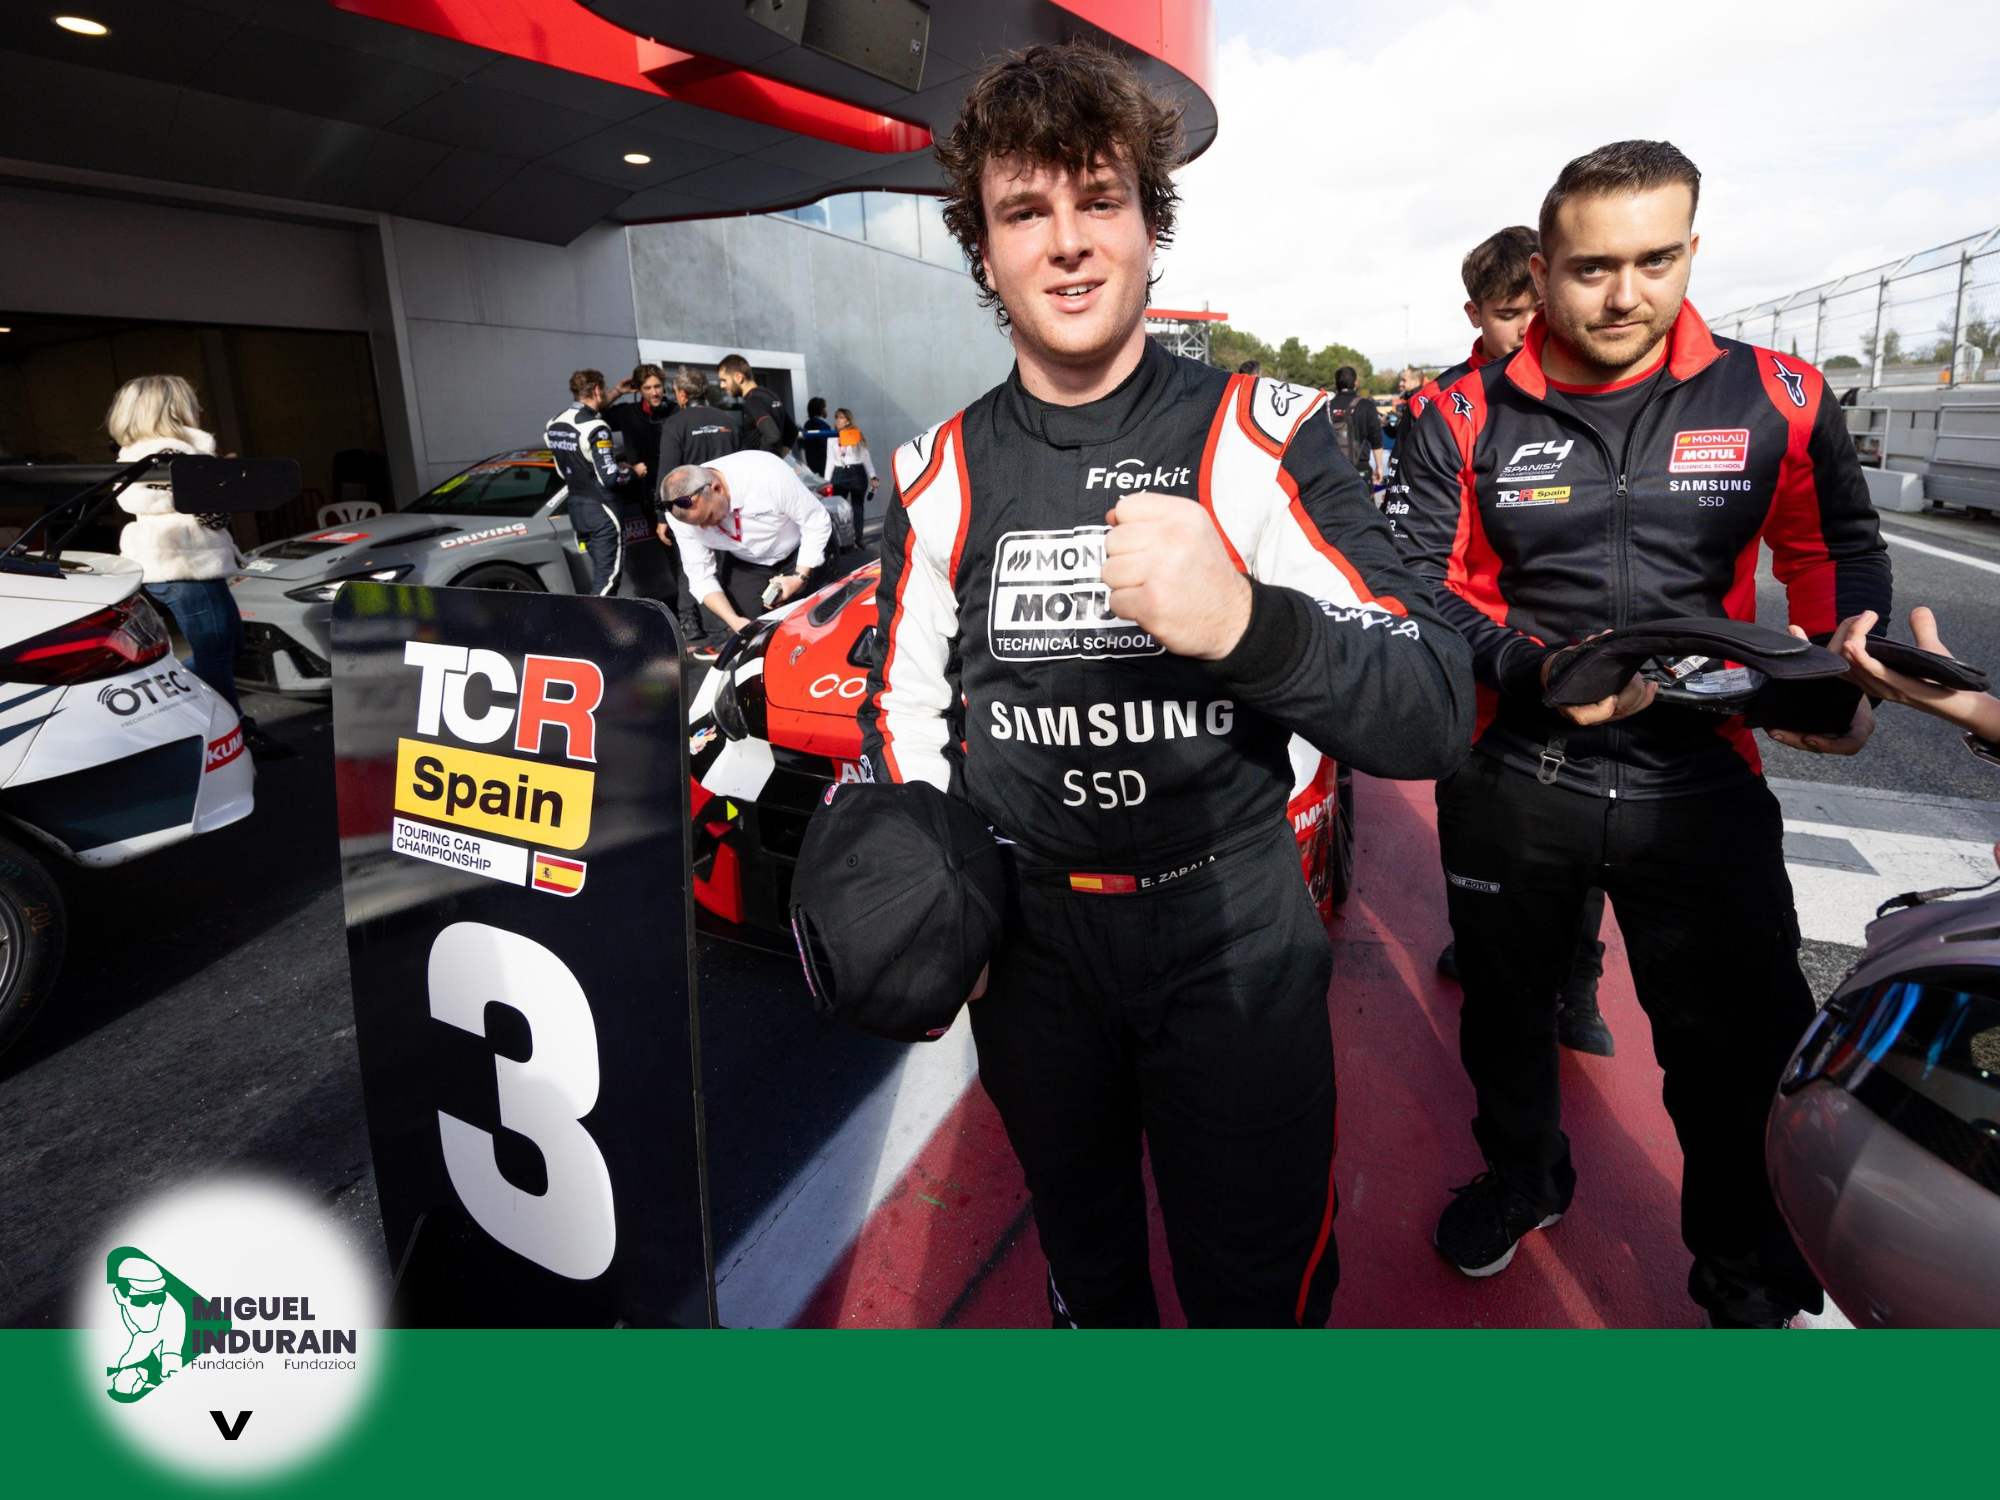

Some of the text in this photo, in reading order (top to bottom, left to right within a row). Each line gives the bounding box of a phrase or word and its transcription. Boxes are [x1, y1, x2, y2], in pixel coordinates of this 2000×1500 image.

[1692, 434, 1744, 444] MONLAU
[1508, 439, 1575, 466] F4
[1681, 449, 1737, 461] MOTUL
[1085, 466, 1191, 490] Frenkit
[1502, 461, 1563, 473] SPANISH
[1497, 489, 1567, 503] TCR Spain
[1669, 479, 1752, 492] SAMSUNG
[1698, 496, 1725, 507] SSD
[440, 522, 527, 549] DRIVING
[1036, 545, 1103, 571] MON
[996, 634, 1155, 651] TECHNICAL SCHOOL
[104, 671, 192, 717] OTEC
[404, 640, 604, 763] TCR
[990, 700, 1234, 747] SAMSUNG
[412, 755, 563, 828] Spain
[1063, 769, 1146, 809] SSD
[398, 823, 481, 855] TOURING CAR
[396, 837, 492, 871] CHAMPIONSHIP
[1141, 877, 1155, 888] E.
[427, 921, 617, 1281] 3
